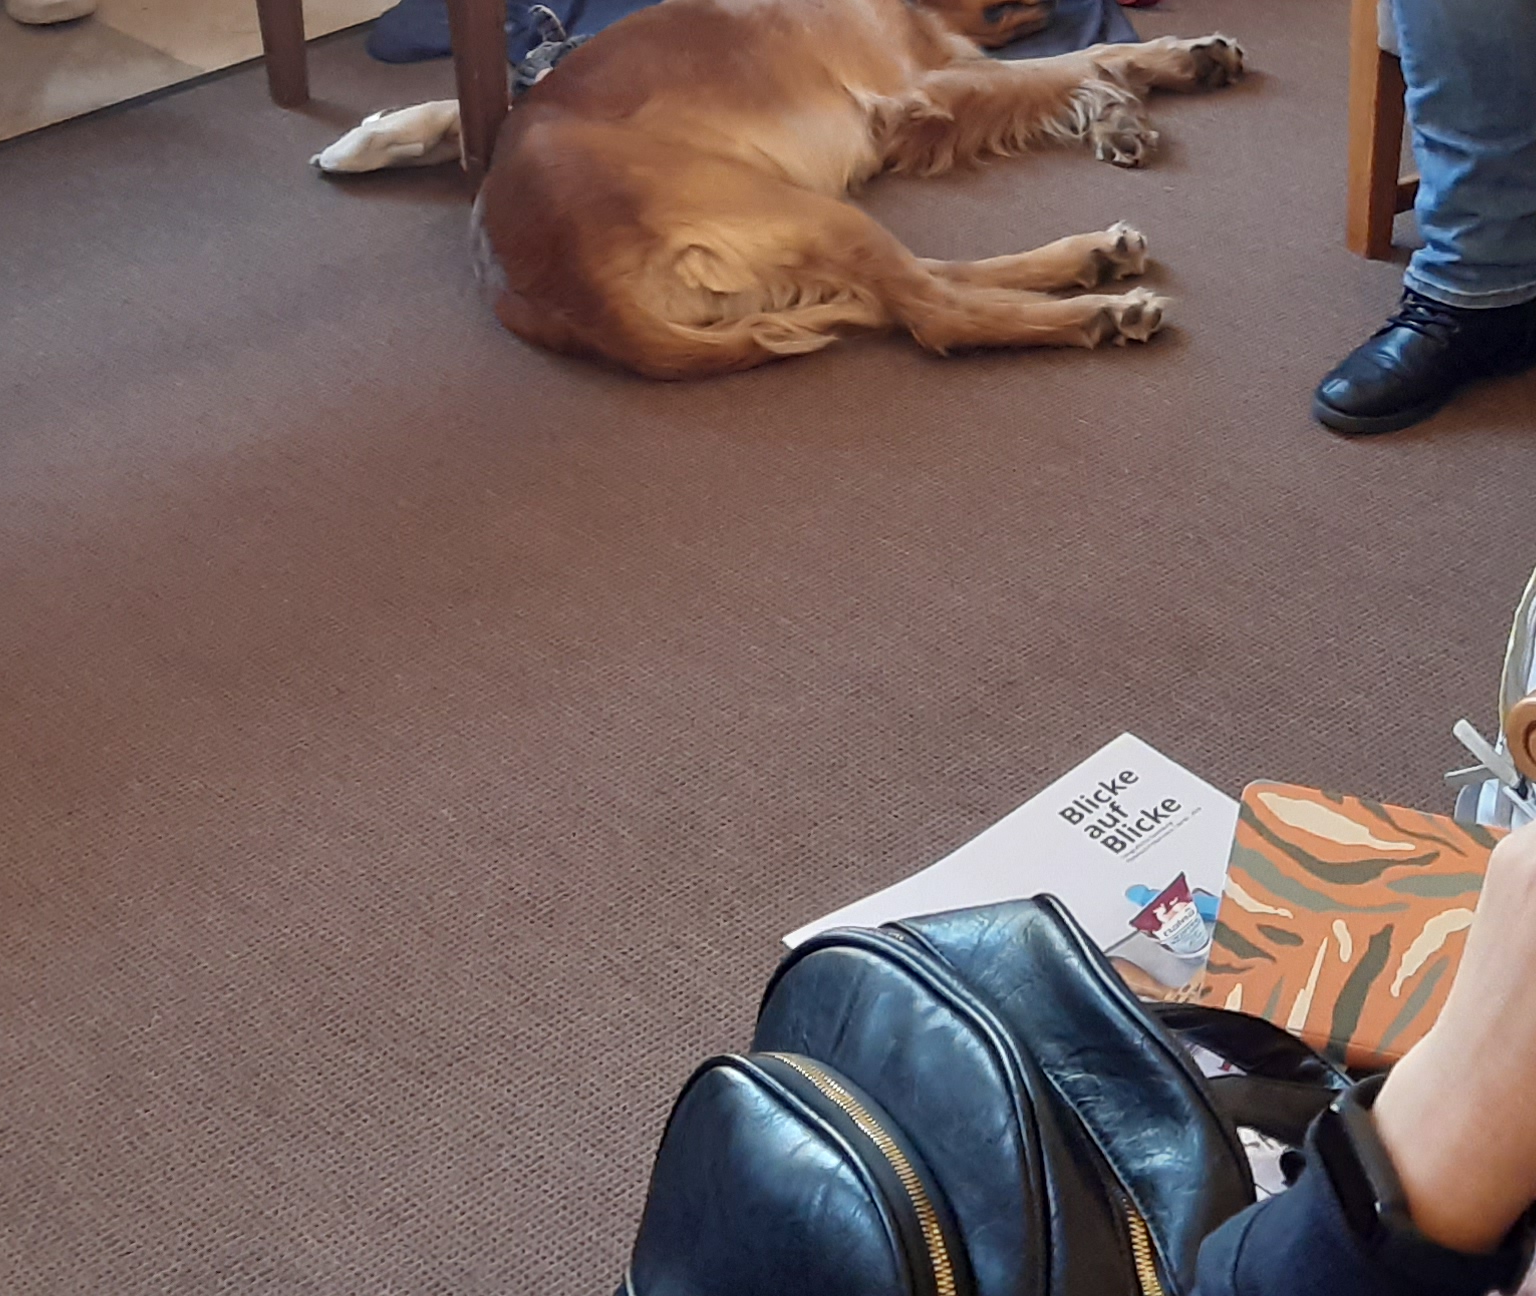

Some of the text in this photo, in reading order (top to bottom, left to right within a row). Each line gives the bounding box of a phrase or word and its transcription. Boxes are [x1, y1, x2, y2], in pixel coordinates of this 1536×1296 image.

[1058, 770, 1139, 826] Blicke
[1084, 800, 1128, 839] auf
[1100, 798, 1182, 854] Blicke
